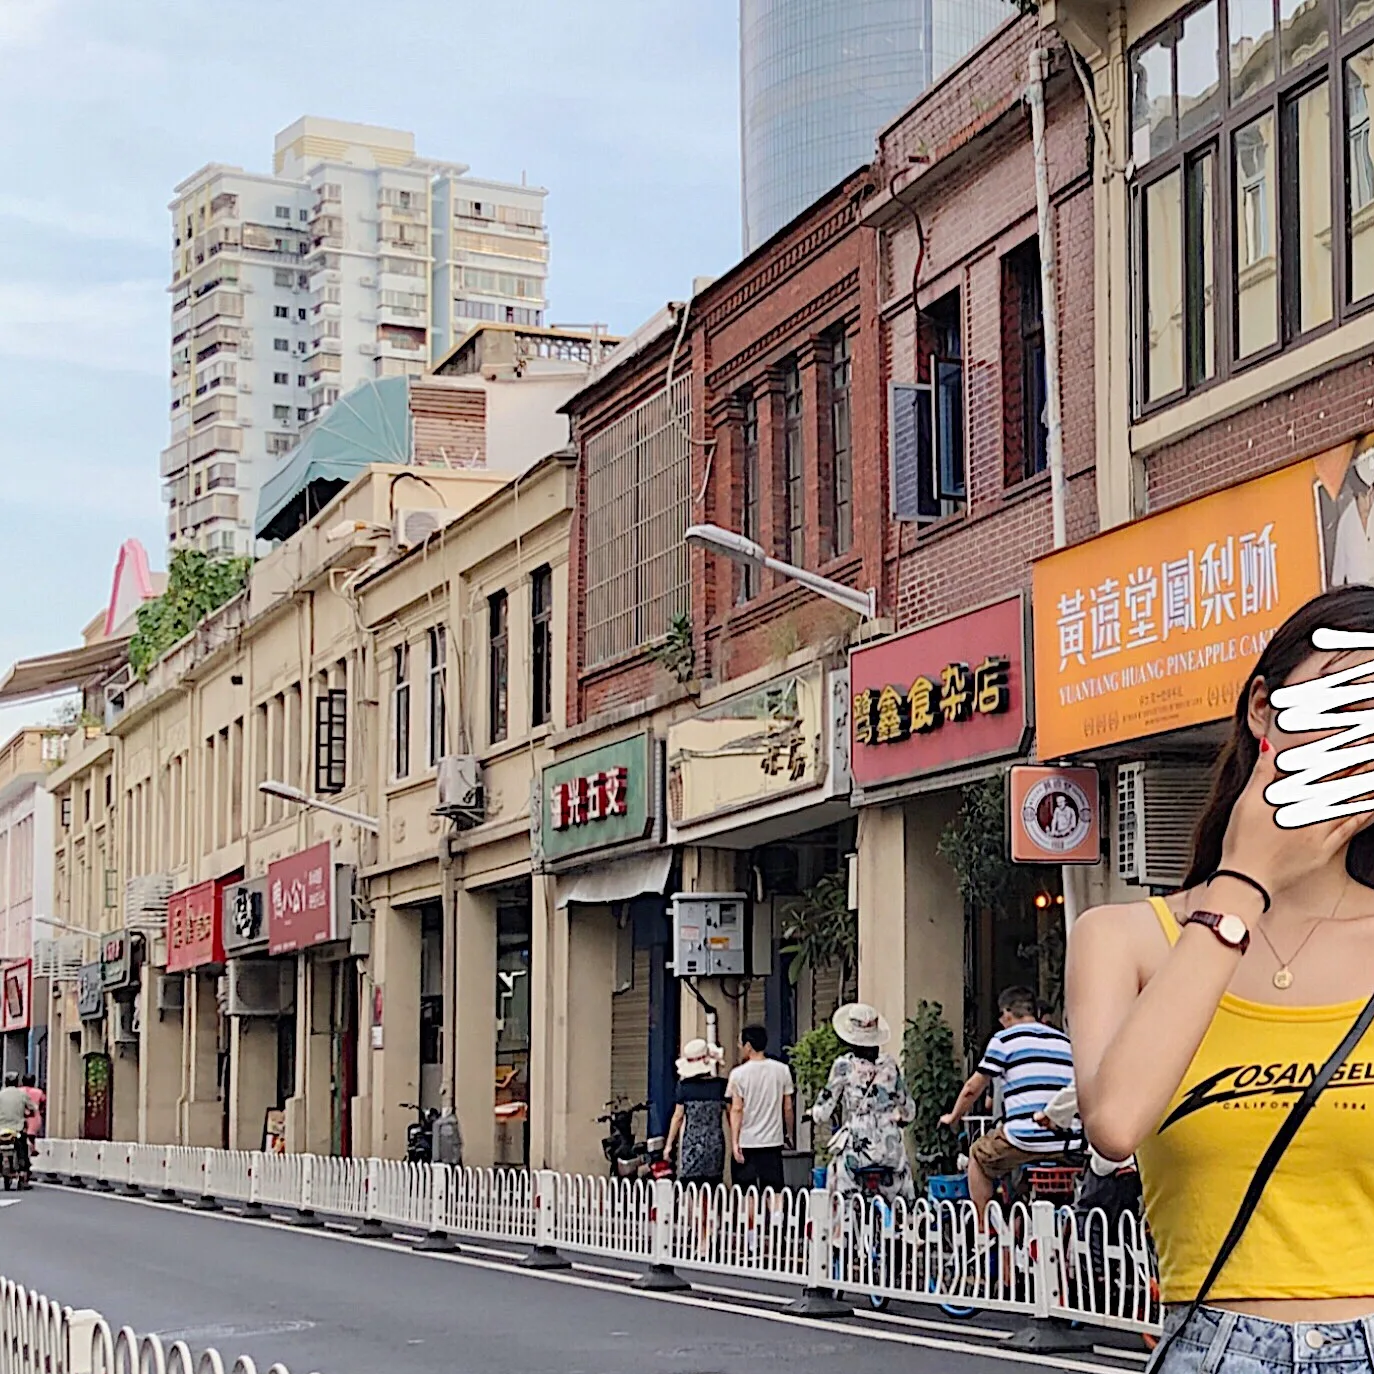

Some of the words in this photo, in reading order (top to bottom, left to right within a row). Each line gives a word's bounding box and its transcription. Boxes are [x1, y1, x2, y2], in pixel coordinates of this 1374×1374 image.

[1058, 673, 1119, 706] YUANTANG
[1121, 657, 1165, 687] HUANG
[1166, 638, 1237, 676] PINEAPPLE
[1222, 1101, 1316, 1111] CALIFOR
